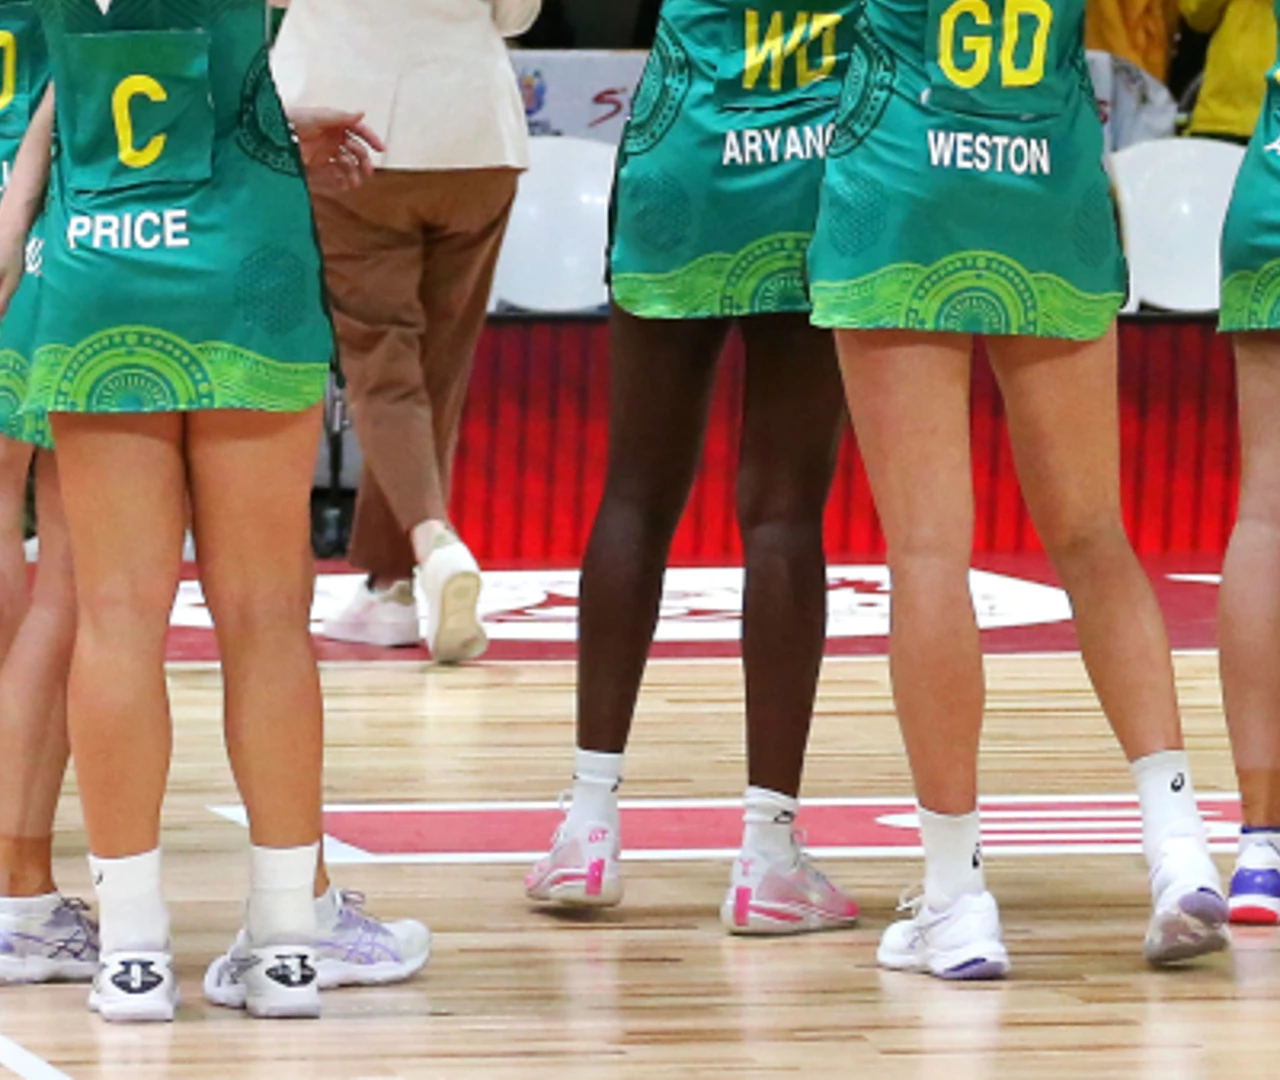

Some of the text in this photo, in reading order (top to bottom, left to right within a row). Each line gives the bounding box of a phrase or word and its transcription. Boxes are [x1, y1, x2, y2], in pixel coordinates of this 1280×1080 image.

[112, 74, 167, 168] C
[927, 129, 1050, 175] WESTON
[67, 209, 190, 249] PRICE
